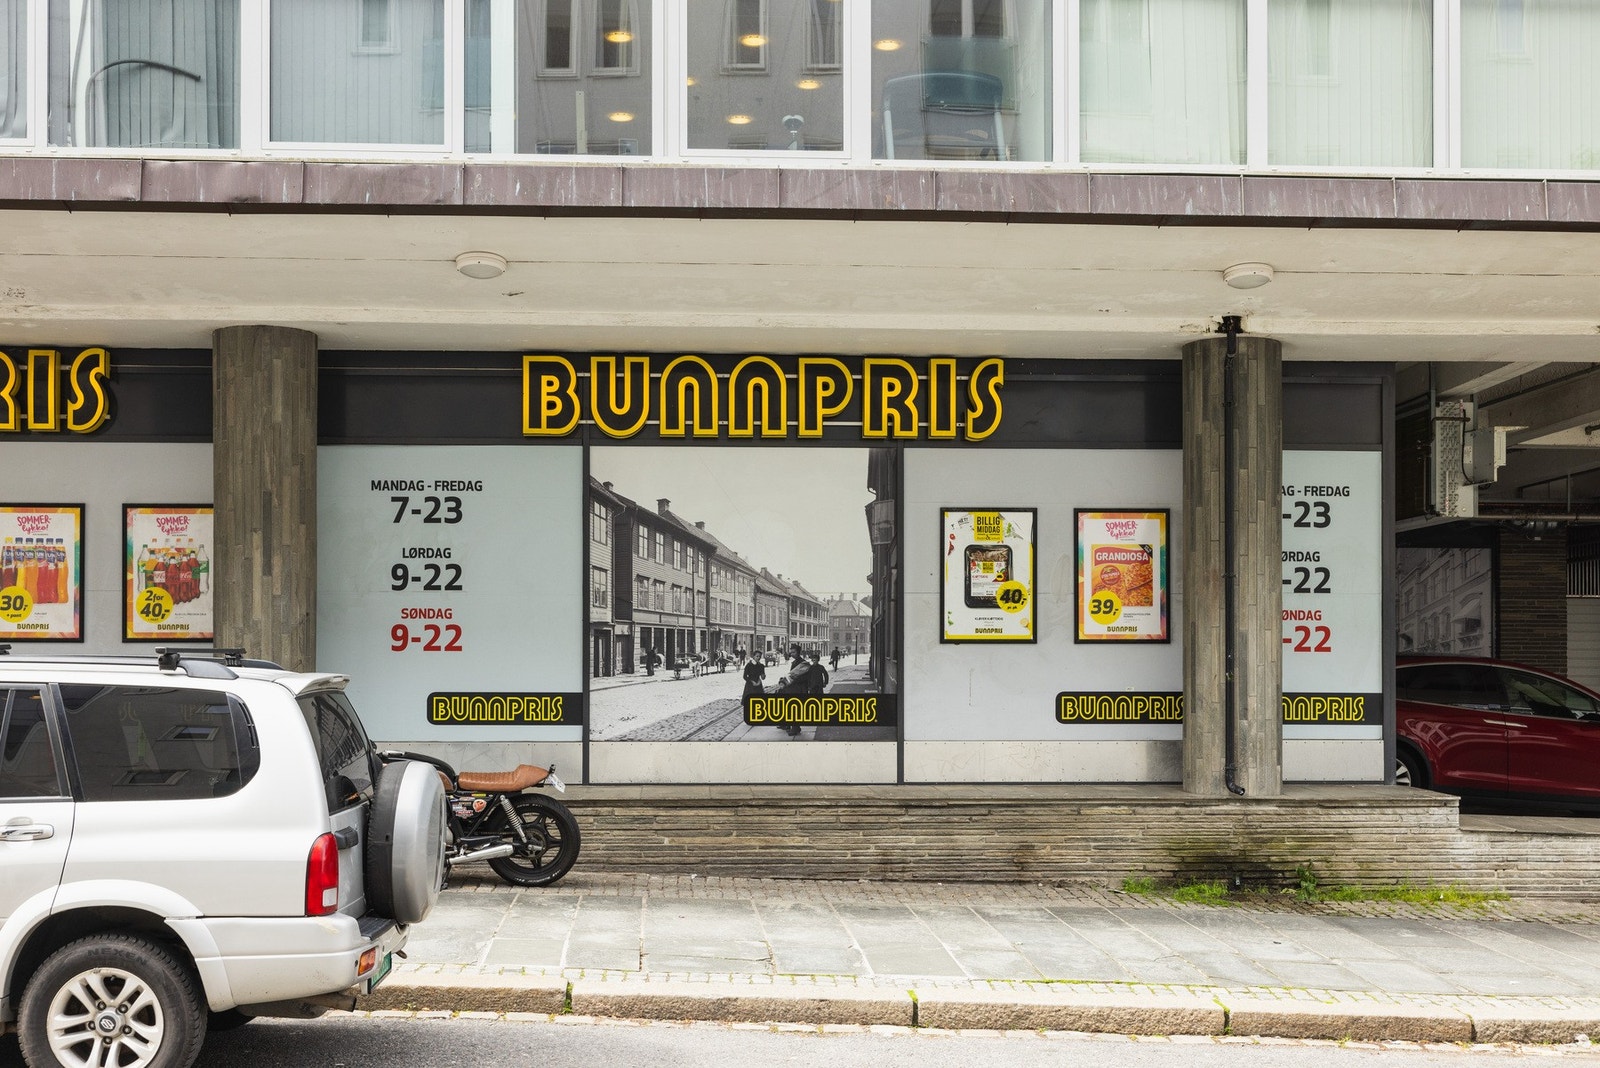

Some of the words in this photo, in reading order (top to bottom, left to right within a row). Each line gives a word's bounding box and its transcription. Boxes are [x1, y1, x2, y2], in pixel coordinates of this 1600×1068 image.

[522, 355, 1004, 441] BUNNPRIS
[371, 480, 425, 491] MANDAG
[434, 480, 483, 492] FREDAG
[1304, 485, 1350, 497] FREDAG
[391, 496, 463, 524] 7-23
[976, 516, 1001, 525] BILLIG
[402, 547, 451, 559] LØRDAG
[1096, 552, 1149, 561] GRANDIOSA
[391, 563, 463, 591] 9-22
[401, 608, 453, 619] SØNDAG
[391, 624, 463, 652] 9-22
[433, 696, 563, 721] BUNNPRIS
[750, 698, 876, 722] BUNNPRIS
